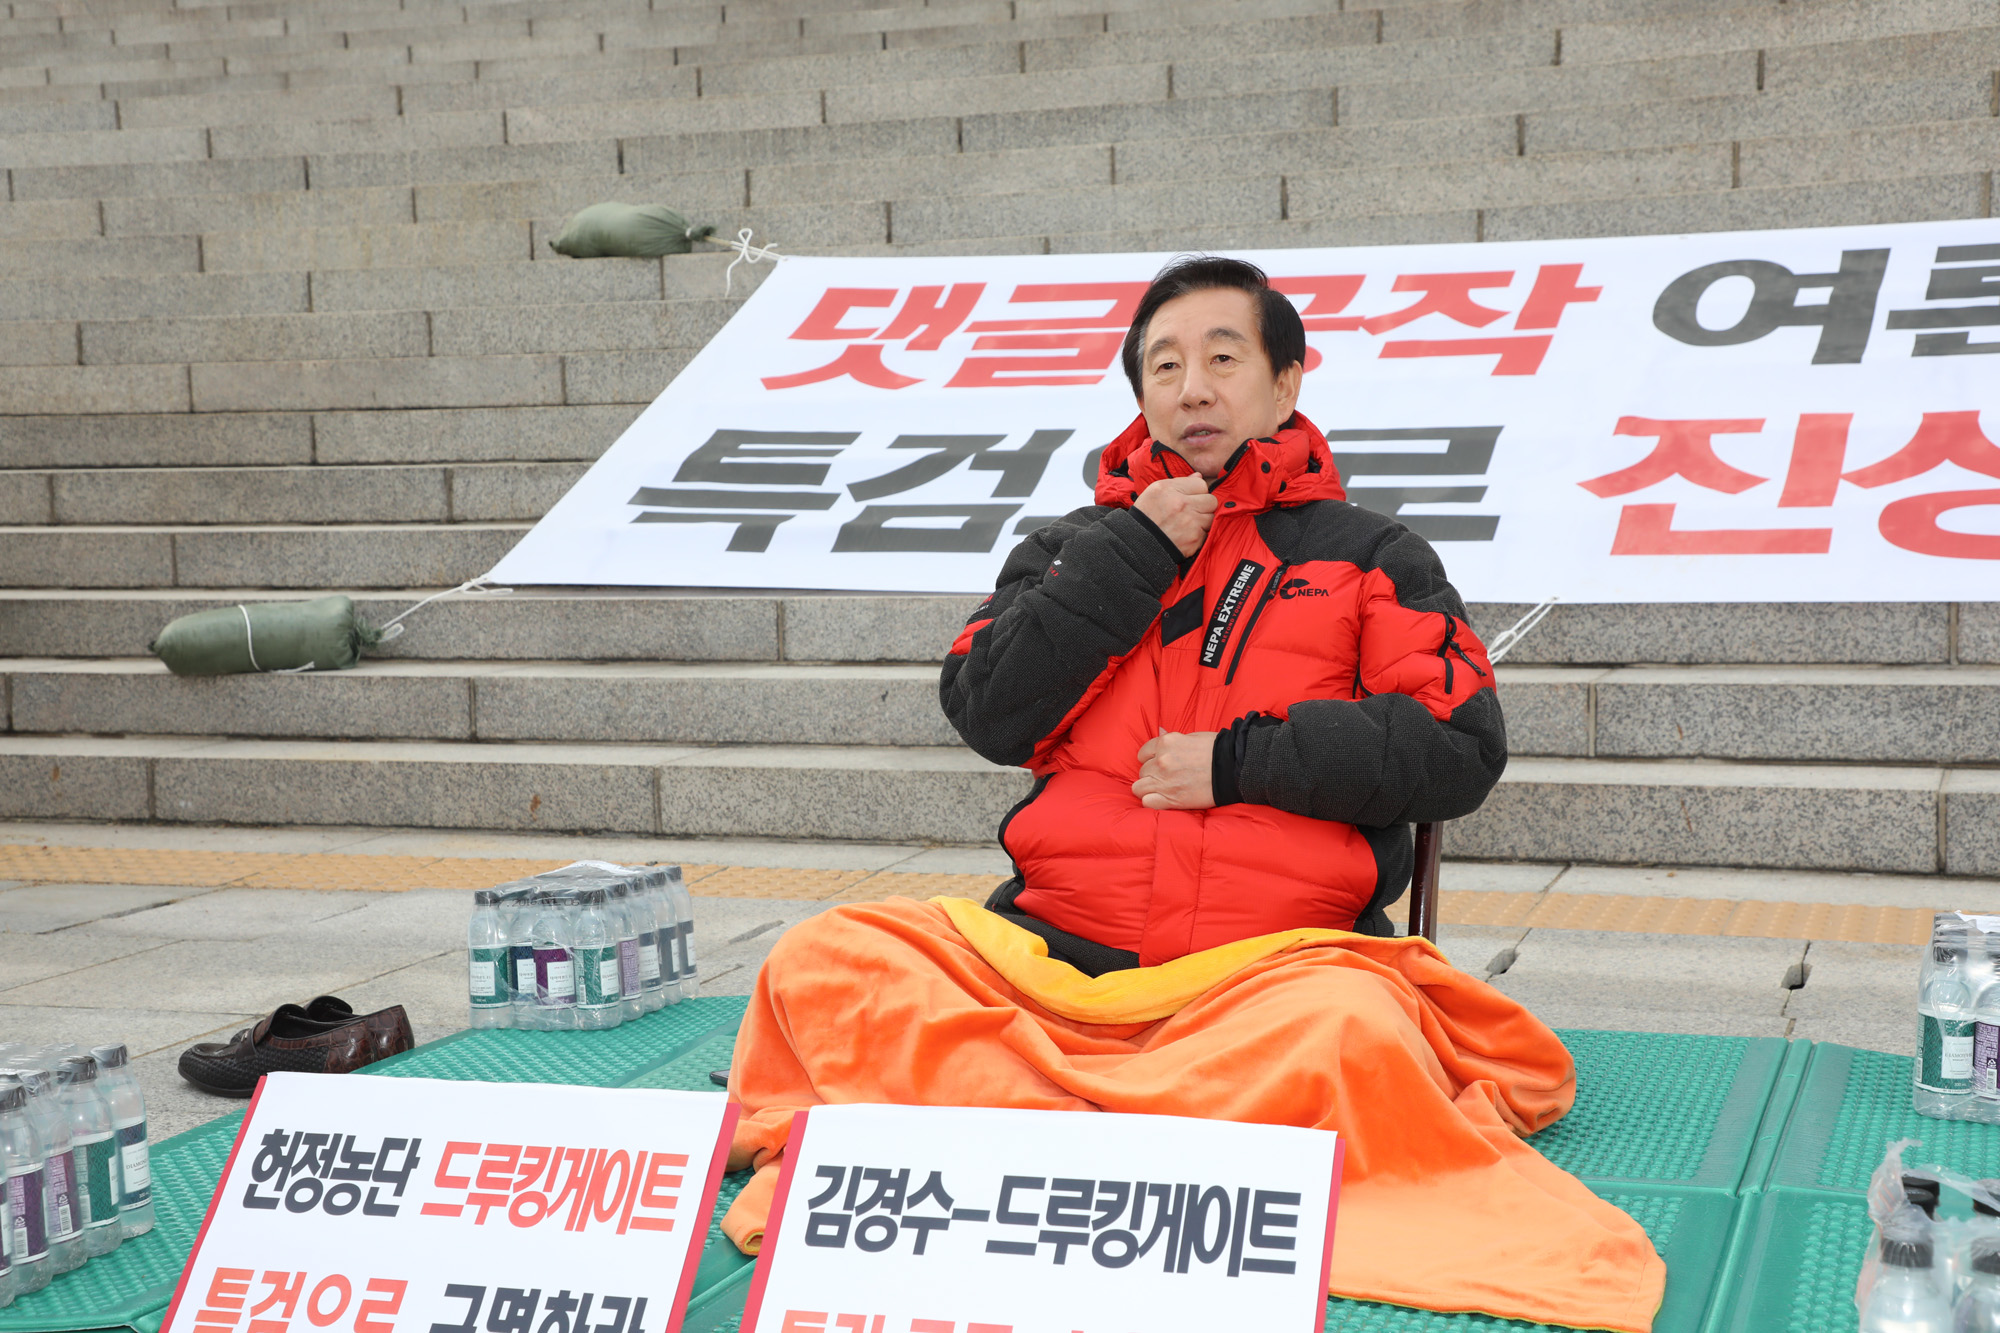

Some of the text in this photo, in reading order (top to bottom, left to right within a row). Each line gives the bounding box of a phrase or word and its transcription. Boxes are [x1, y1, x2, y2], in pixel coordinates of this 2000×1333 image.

[627, 425, 1505, 553] 특검로
[1203, 564, 1256, 663] NEPA EXTREME
[1297, 588, 1330, 597] NEPA
[242, 1128, 690, 1236] 헌정농단 드루킹게이트
[804, 1164, 1302, 1278] 김경수-드루킹게이트
